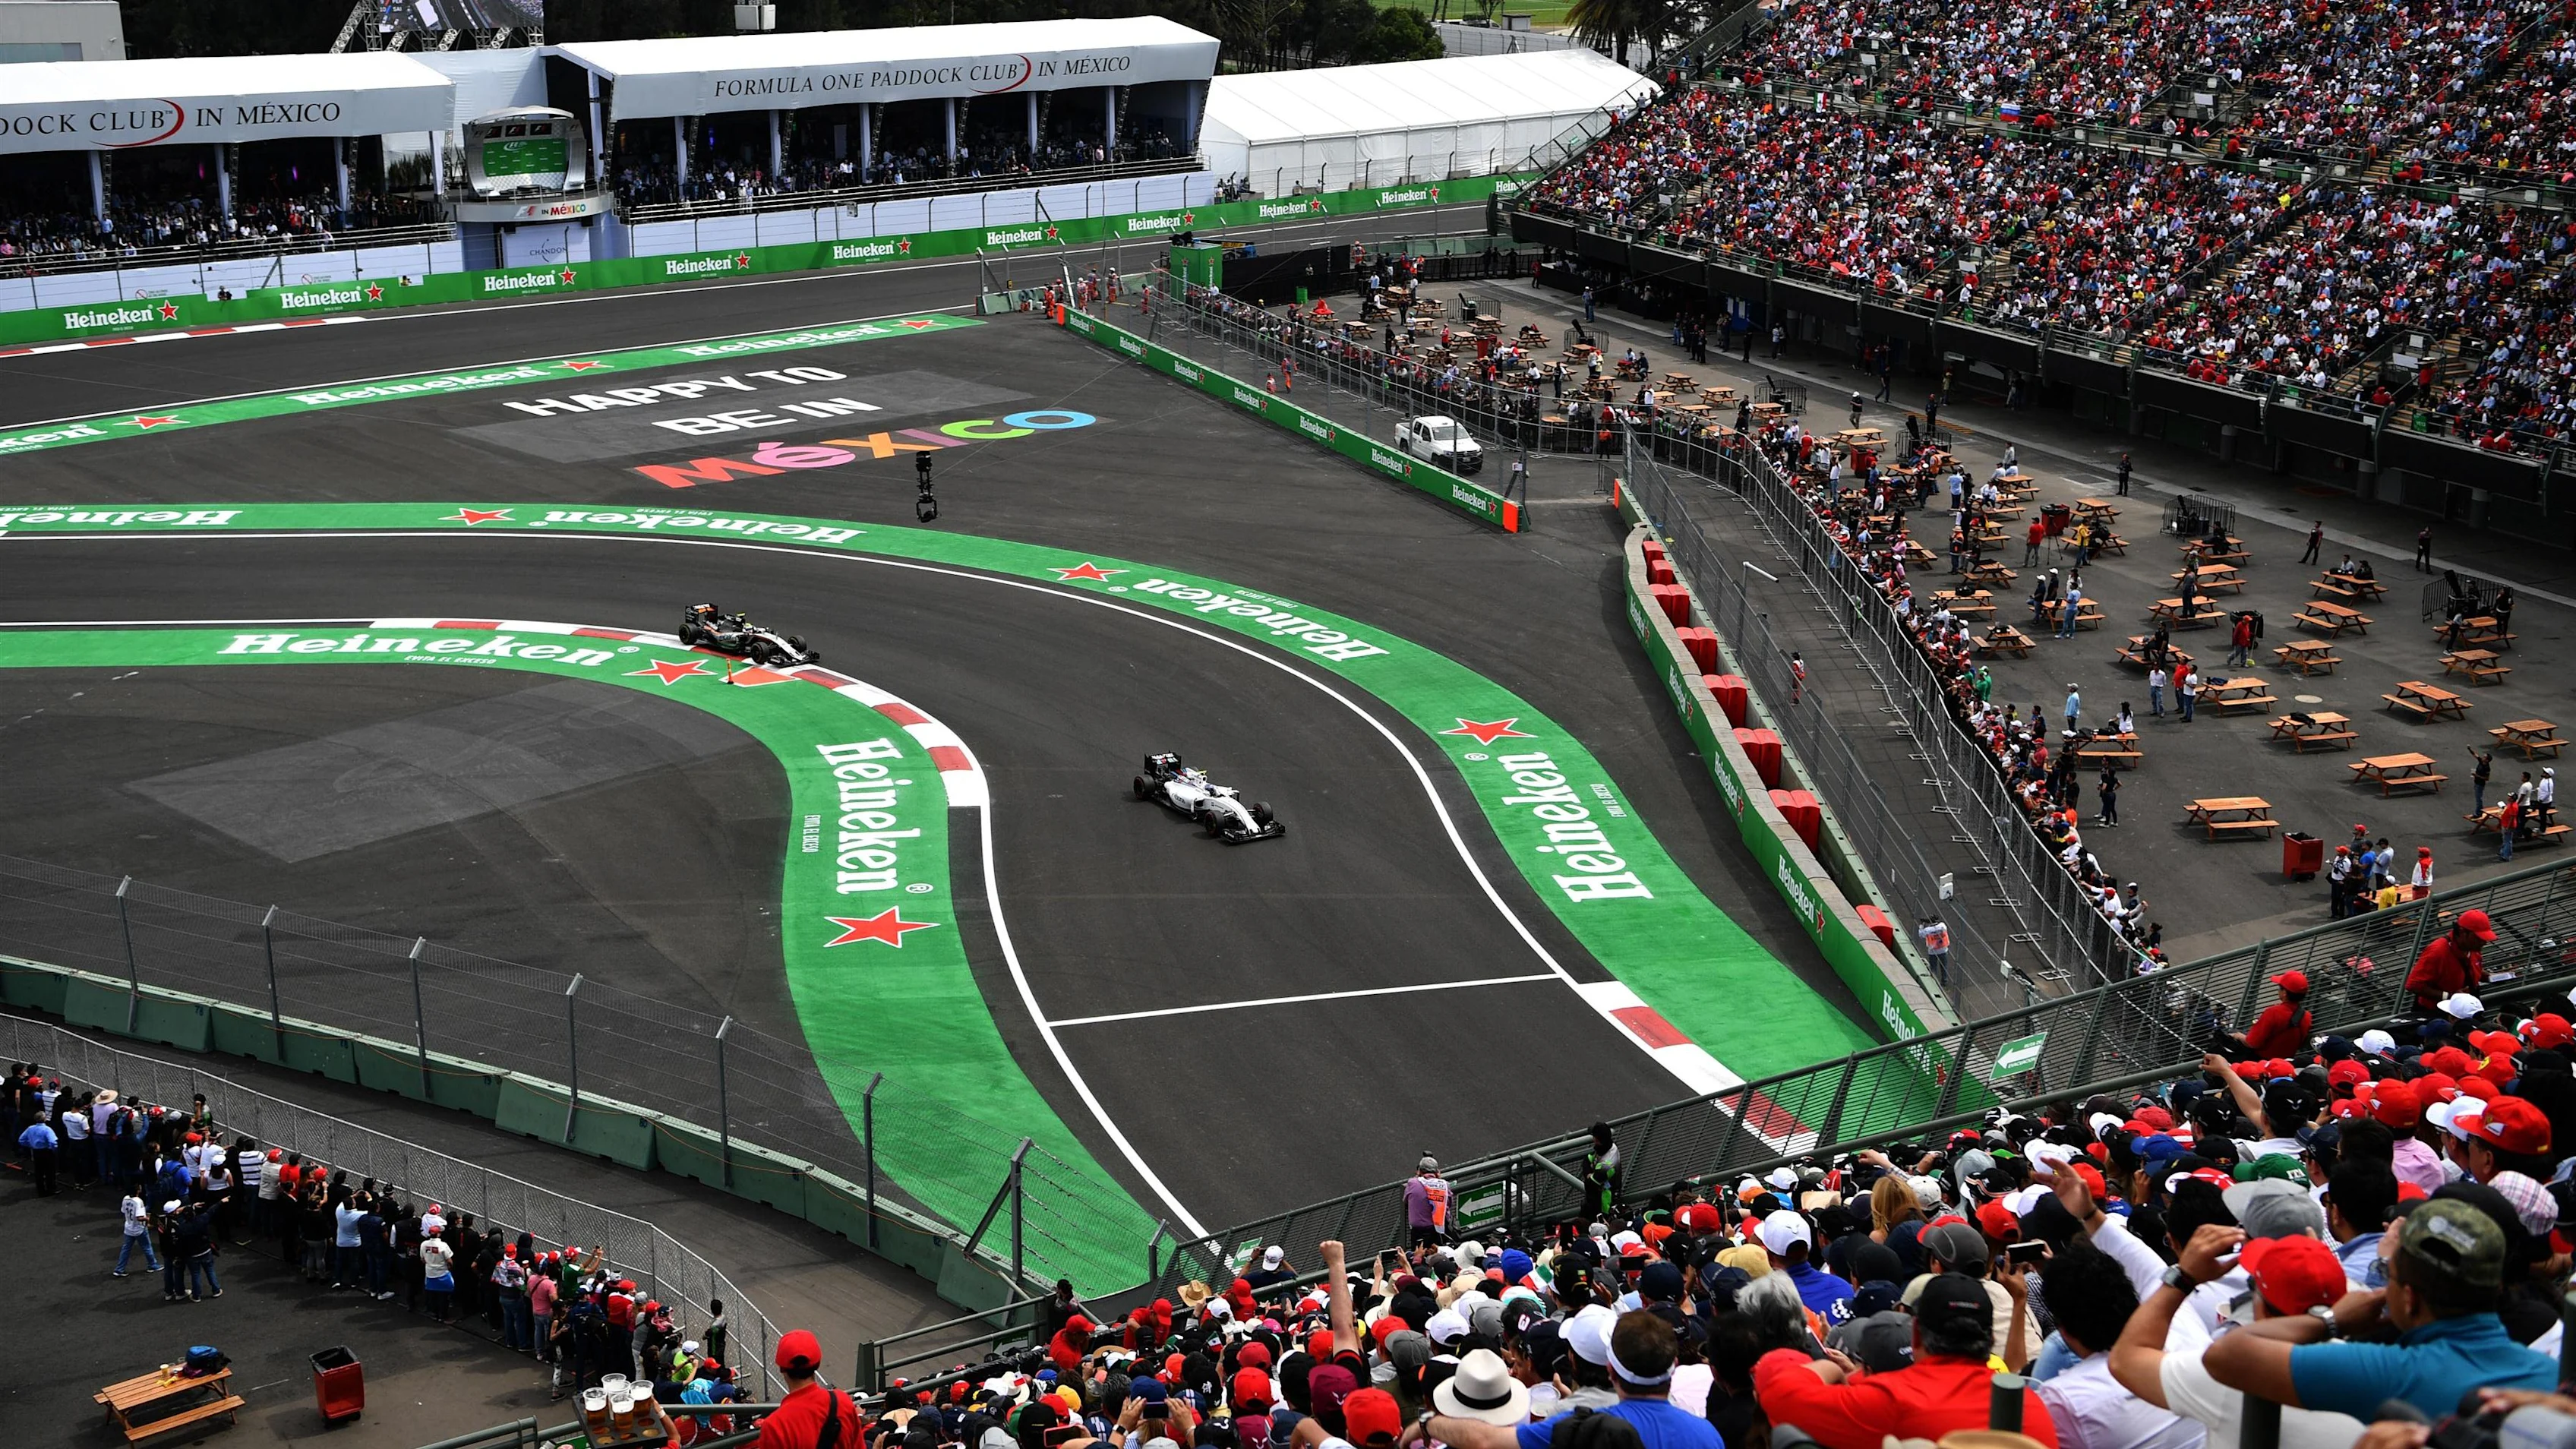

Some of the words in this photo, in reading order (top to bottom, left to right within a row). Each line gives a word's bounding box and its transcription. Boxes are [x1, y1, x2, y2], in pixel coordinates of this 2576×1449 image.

[715, 76, 813, 97] FORMULA
[822, 72, 864, 90] ONE
[870, 67, 962, 87] PADDOCK
[970, 63, 1017, 80] CLUB
[1037, 61, 1058, 77] IN
[1063, 55, 1131, 75] MÉXICO
[90, 109, 165, 131] CLUB
[195, 107, 225, 127] IN
[235, 101, 341, 126] MÉXICO
[1381, 190, 1427, 204] Heineken
[1259, 202, 1307, 217] Heineken
[1128, 215, 1182, 232] Heineken
[987, 229, 1042, 245] Heineken
[833, 243, 895, 260] Heineken
[665, 257, 732, 275] Heineken
[484, 273, 555, 292] Heineken
[280, 287, 361, 309] Heineken
[65, 307, 153, 330] Heineken
[1069, 314, 1089, 332] Heineken
[672, 325, 892, 357] Heineken
[1119, 336, 1141, 355] Heineken
[1174, 361, 1198, 381] Heineken
[286, 368, 551, 405] Heineken
[503, 375, 758, 416] HAPPY
[747, 366, 848, 385] TO
[1234, 387, 1259, 409] Heineken
[651, 409, 799, 436] BE
[777, 397, 883, 418] IN
[1300, 415, 1327, 439] Heineken
[1372, 448, 1403, 472] Heineken
[1452, 484, 1486, 511] Heineken
[545, 510, 867, 545] Heineken
[1133, 578, 1391, 662] Heineken
[216, 633, 617, 667] Heineken
[1715, 750, 1738, 808] Heineken
[804, 814, 821, 828] EVITA
[815, 737, 920, 895] Heineken
[1497, 751, 1654, 902] Heineken
[802, 835, 819, 853] EXCESO
[1778, 854, 1814, 923] Heineken
